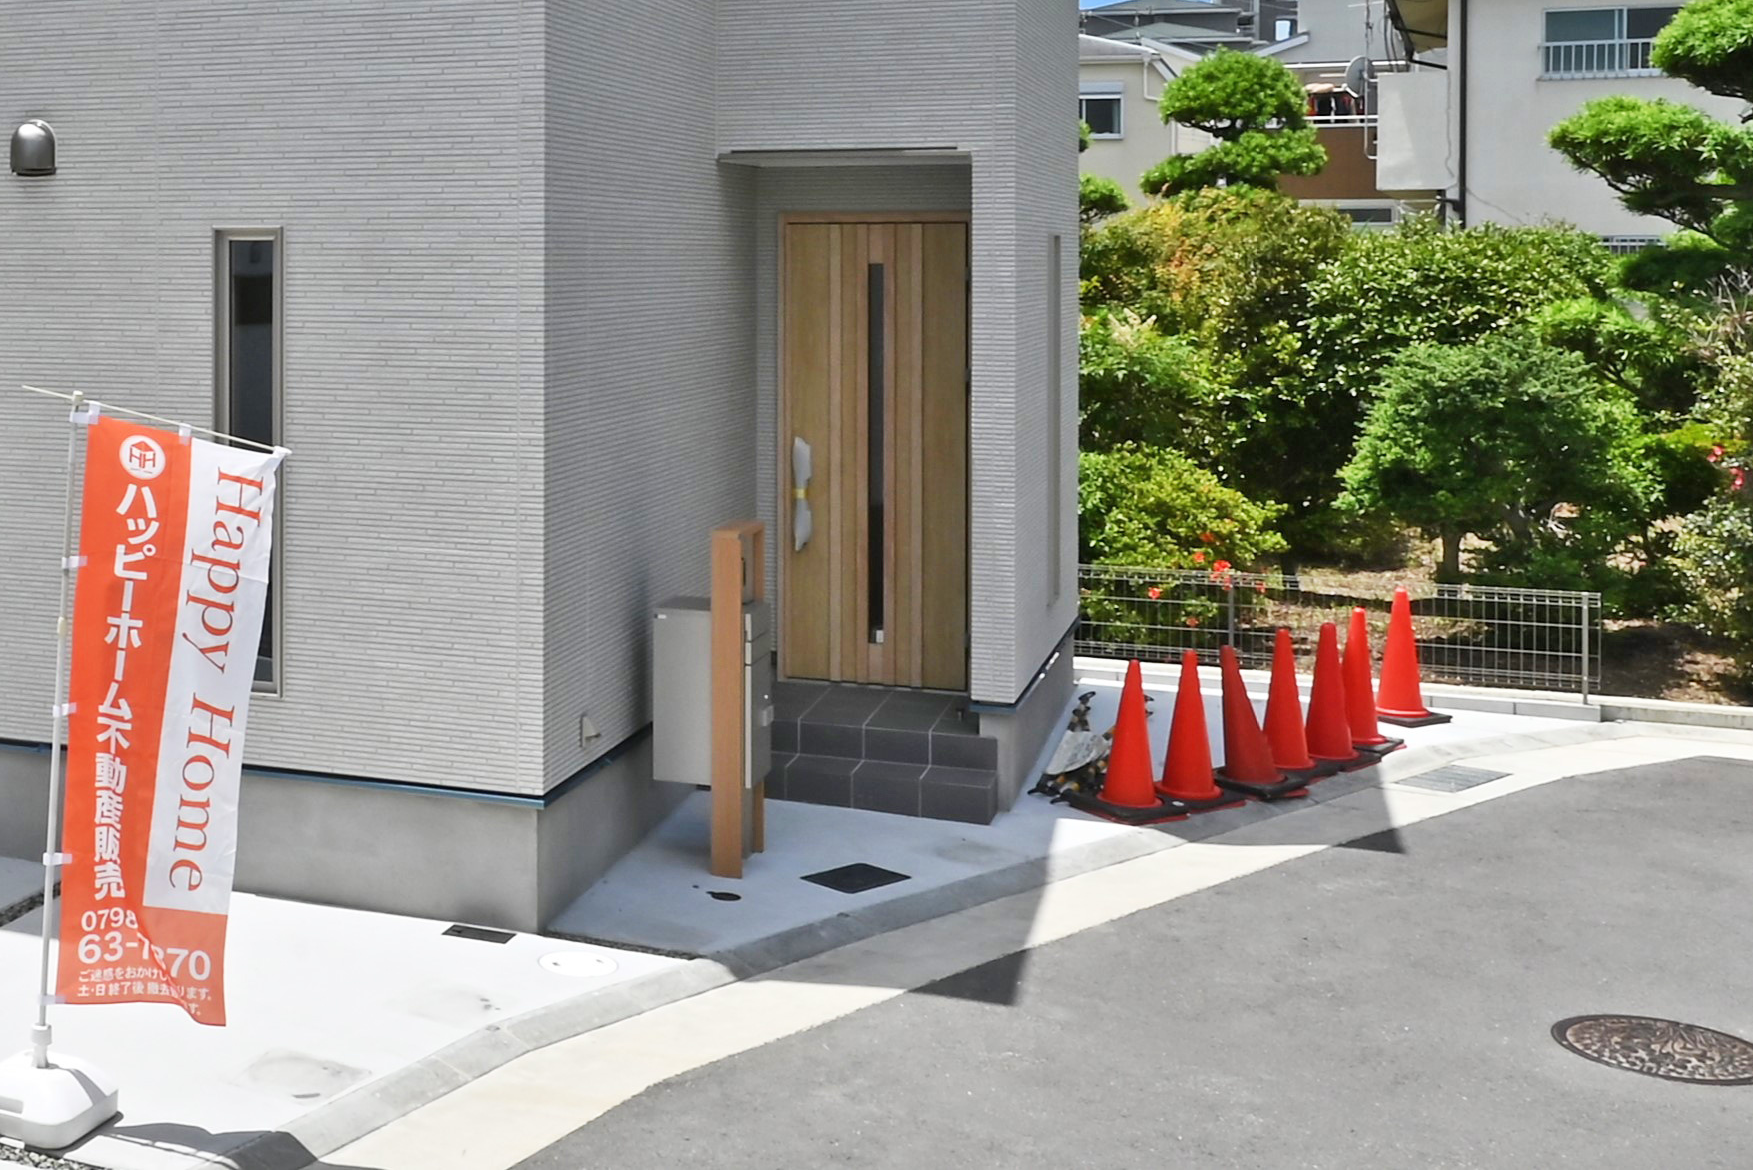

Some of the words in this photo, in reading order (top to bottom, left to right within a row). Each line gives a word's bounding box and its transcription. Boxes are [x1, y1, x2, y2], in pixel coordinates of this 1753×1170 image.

[182, 467, 265, 674] Happy
[93, 483, 160, 901] ハッピーホーム不動産販売
[168, 692, 235, 892] Home
[80, 906, 139, 932] 0798
